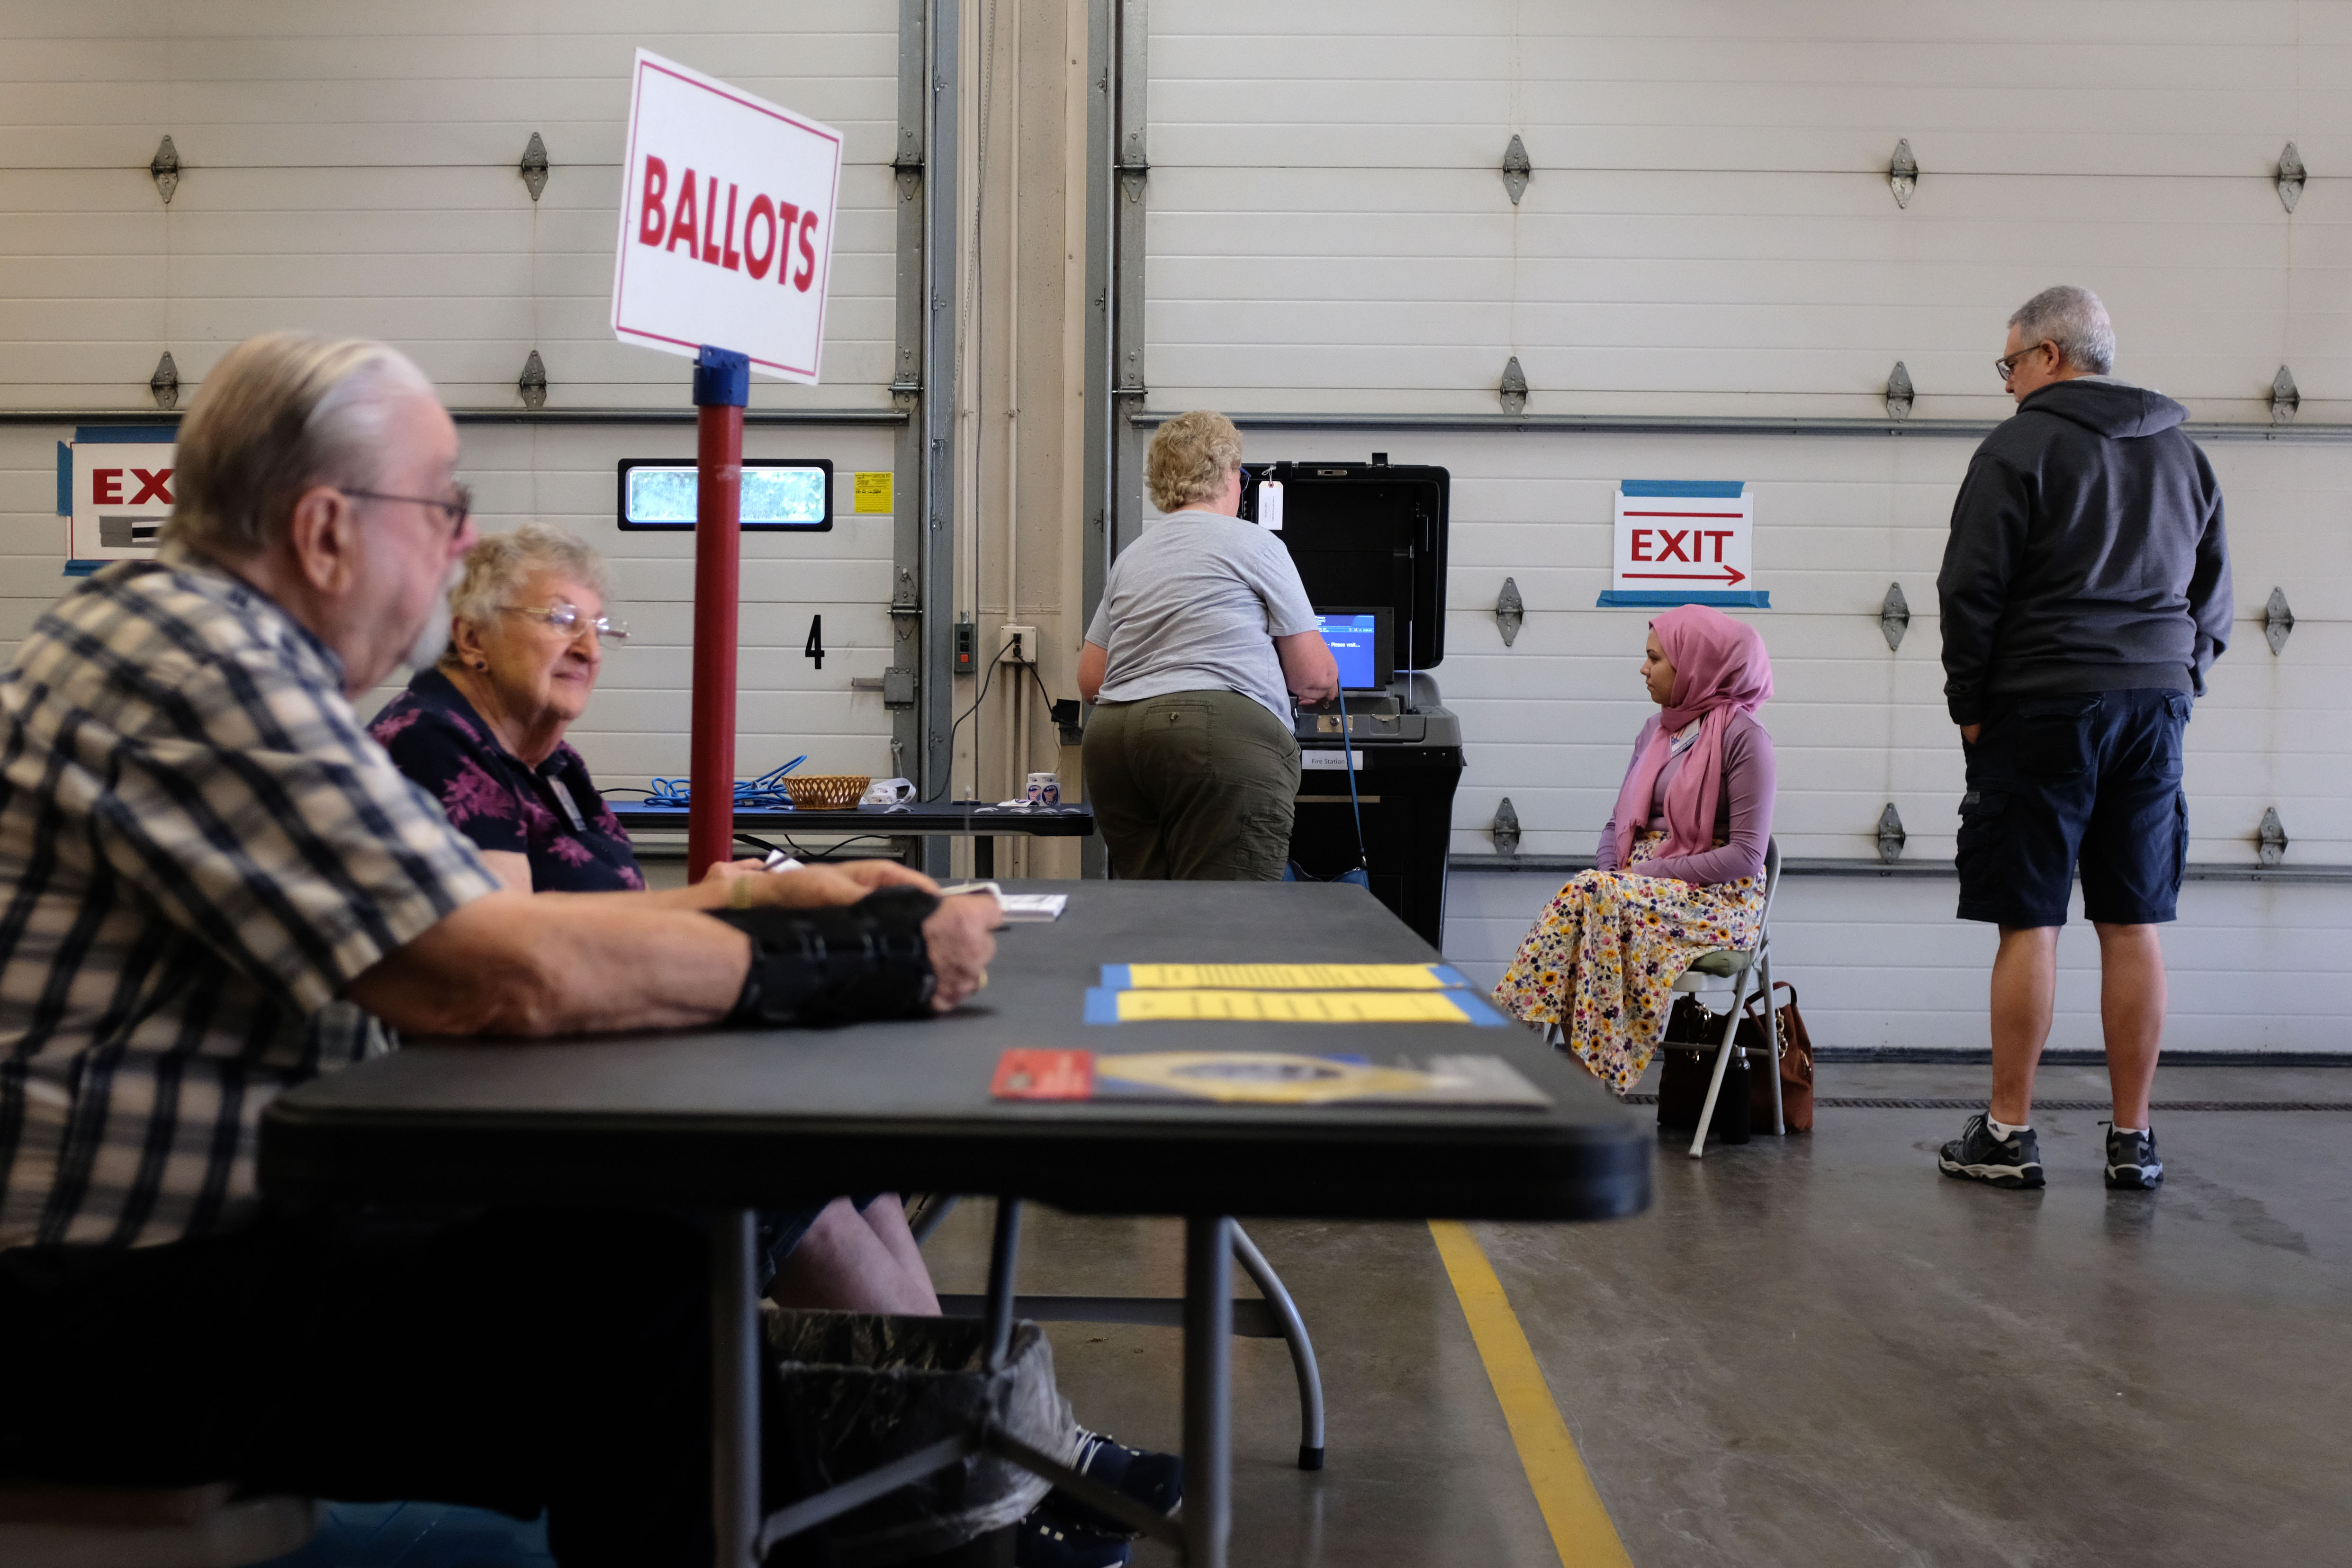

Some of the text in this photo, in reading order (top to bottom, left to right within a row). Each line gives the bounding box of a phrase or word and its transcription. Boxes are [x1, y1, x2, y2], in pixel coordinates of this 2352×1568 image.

[640, 155, 819, 292] BALLOTS
[1631, 529, 1734, 563] EXIT
[805, 614, 825, 670] 4
